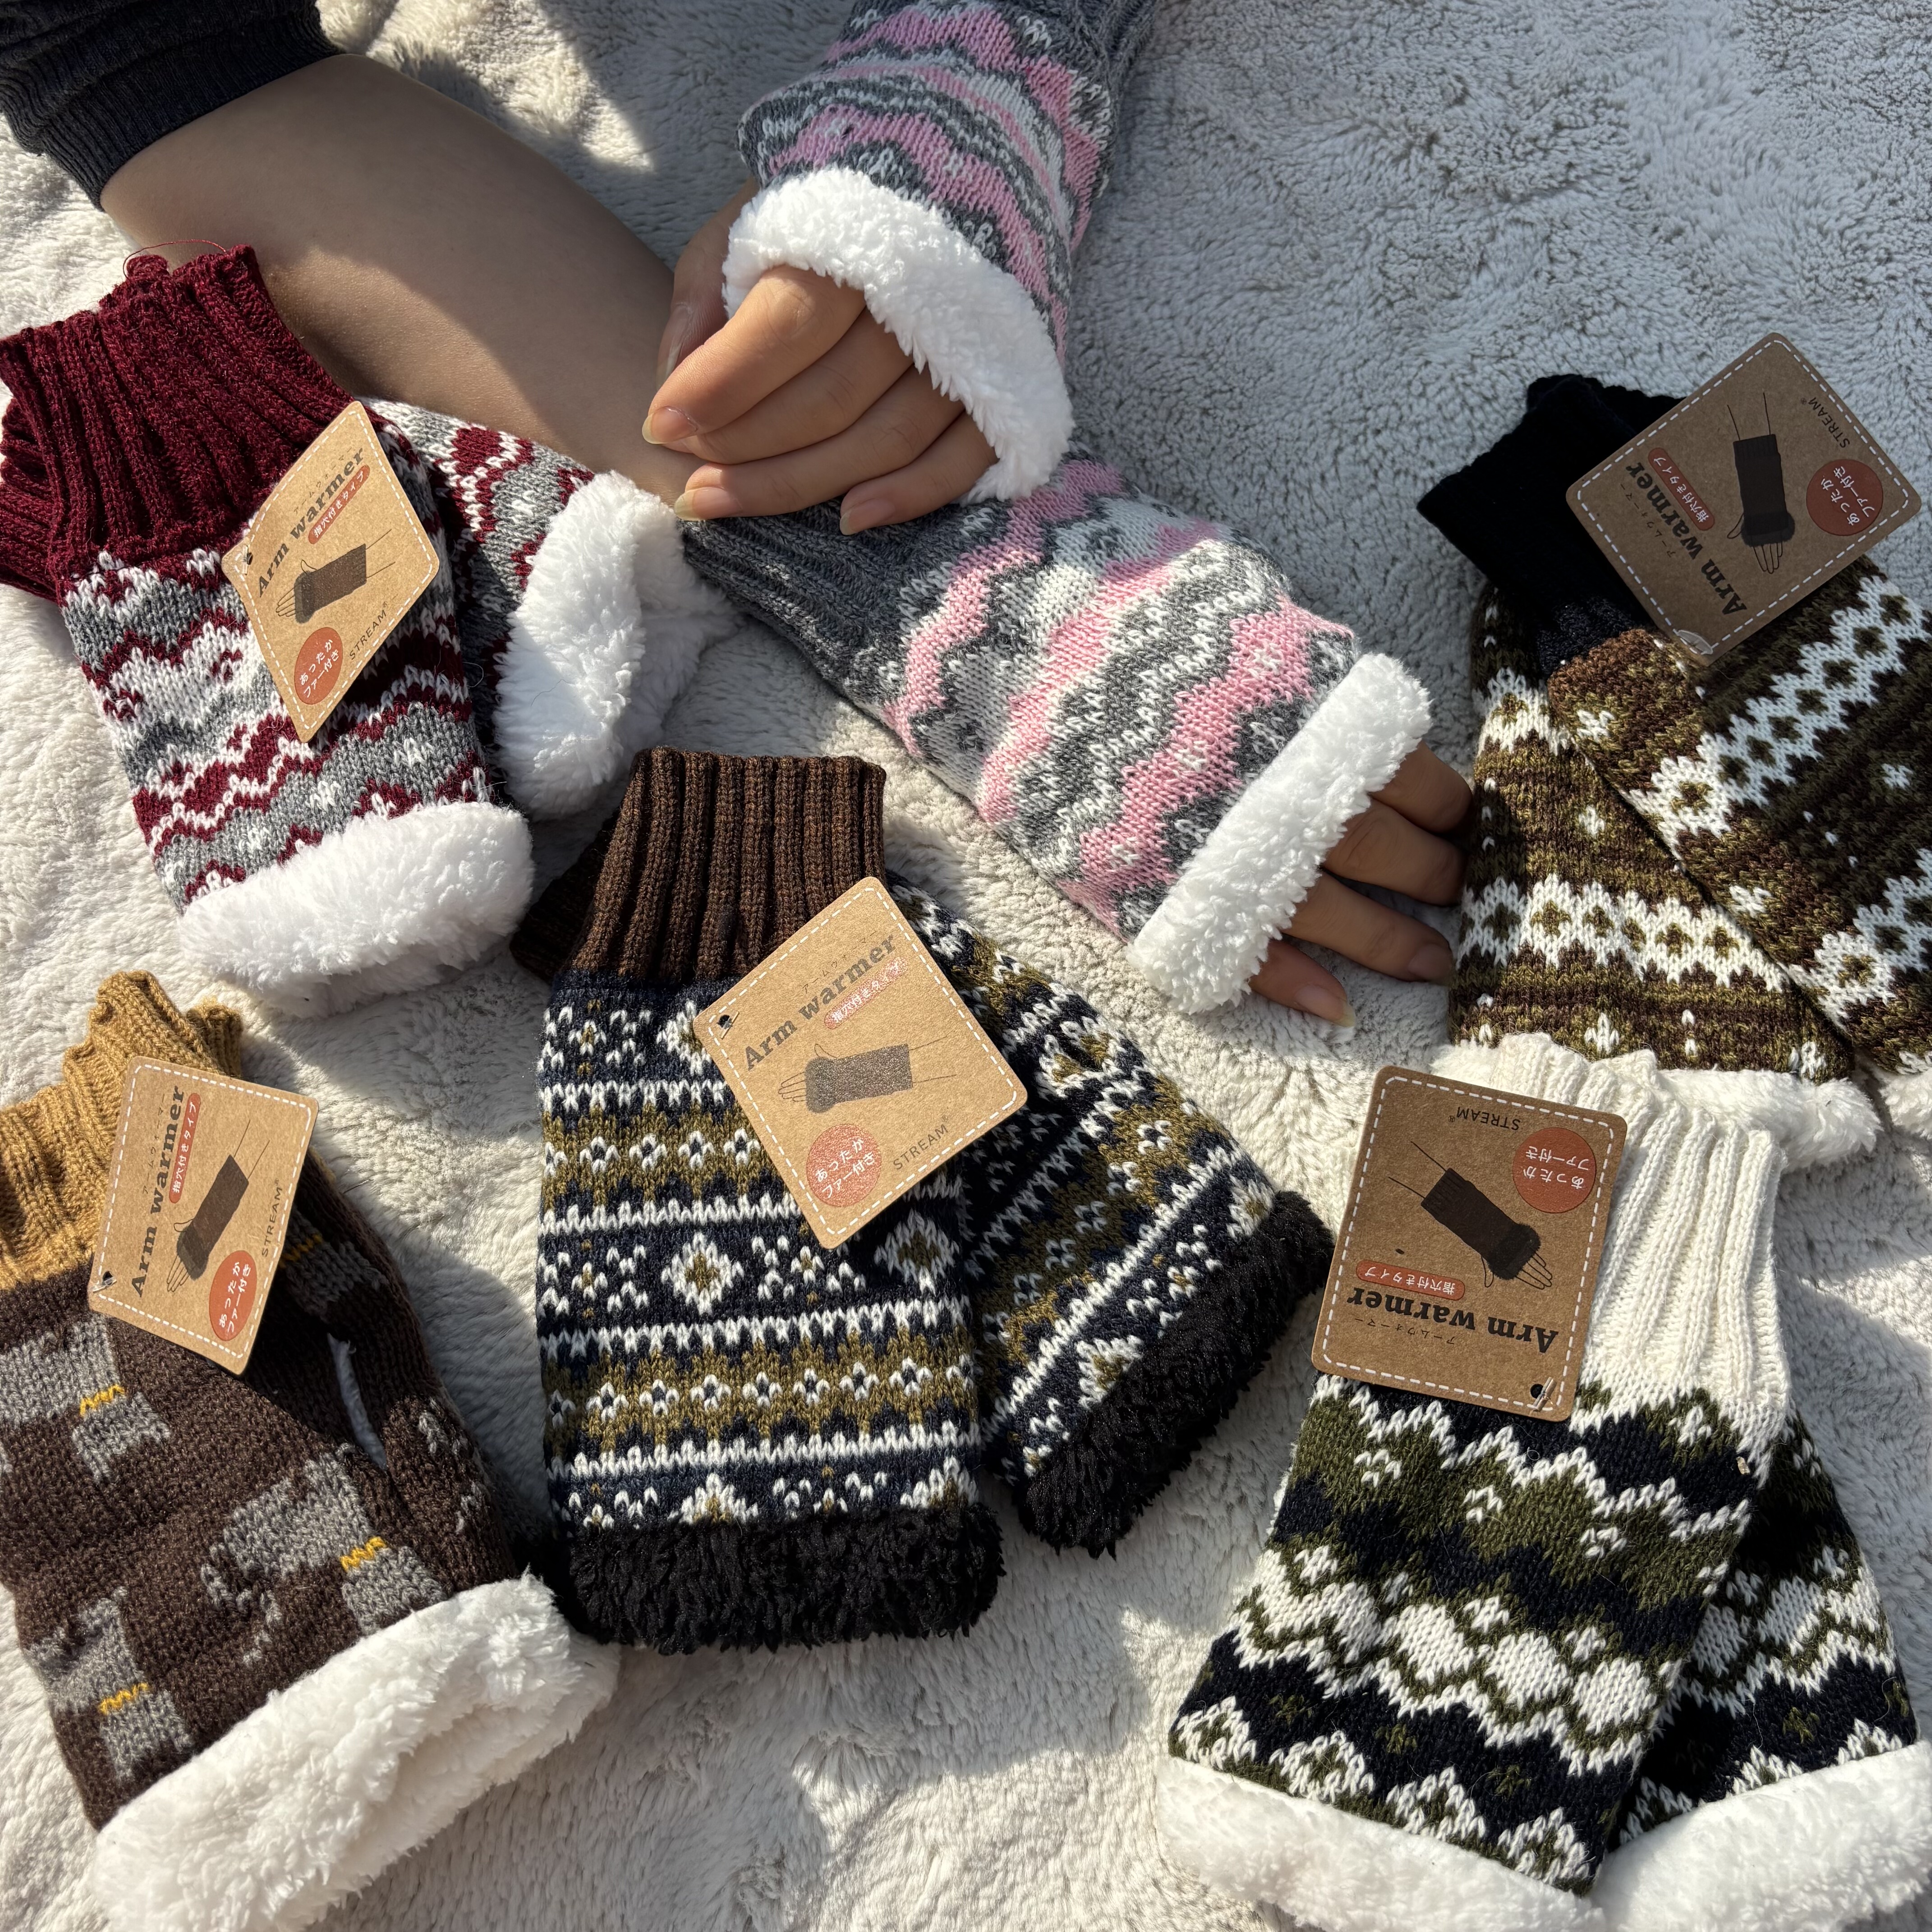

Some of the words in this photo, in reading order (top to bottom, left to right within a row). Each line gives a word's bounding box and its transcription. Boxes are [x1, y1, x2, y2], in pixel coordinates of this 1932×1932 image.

[313, 473, 365, 538] 指穴付きタイプ
[1626, 462, 1702, 559] warmer
[1653, 456, 1709, 523] 指穴付きタイプ
[1821, 478, 1859, 526] あったか
[1834, 466, 1875, 517] ファー付き
[258, 543, 290, 598] Arm
[290, 448, 363, 539] warmer
[1701, 559, 1747, 615] Arm
[300, 639, 333, 684] あったか
[304, 650, 340, 698] ファー付き
[744, 1020, 797, 1071] Arm
[799, 934, 896, 1020] warmer
[172, 1101, 196, 1193] 指穴付きタイプ
[815, 1138, 865, 1182] あったか
[1526, 1145, 1589, 1171] ファー付き
[131, 1226, 157, 1297] Arm
[151, 1086, 184, 1214] warmer
[822, 1154, 875, 1199] ファー付き
[1523, 1167, 1584, 1189] あったか
[219, 1261, 240, 1328] あったか
[227, 1264, 251, 1332] ファー付き
[1365, 1266, 1455, 1294] 指穴付きタイプ
[1347, 1287, 1475, 1329] warmer
[1488, 1317, 1559, 1353] Arm
